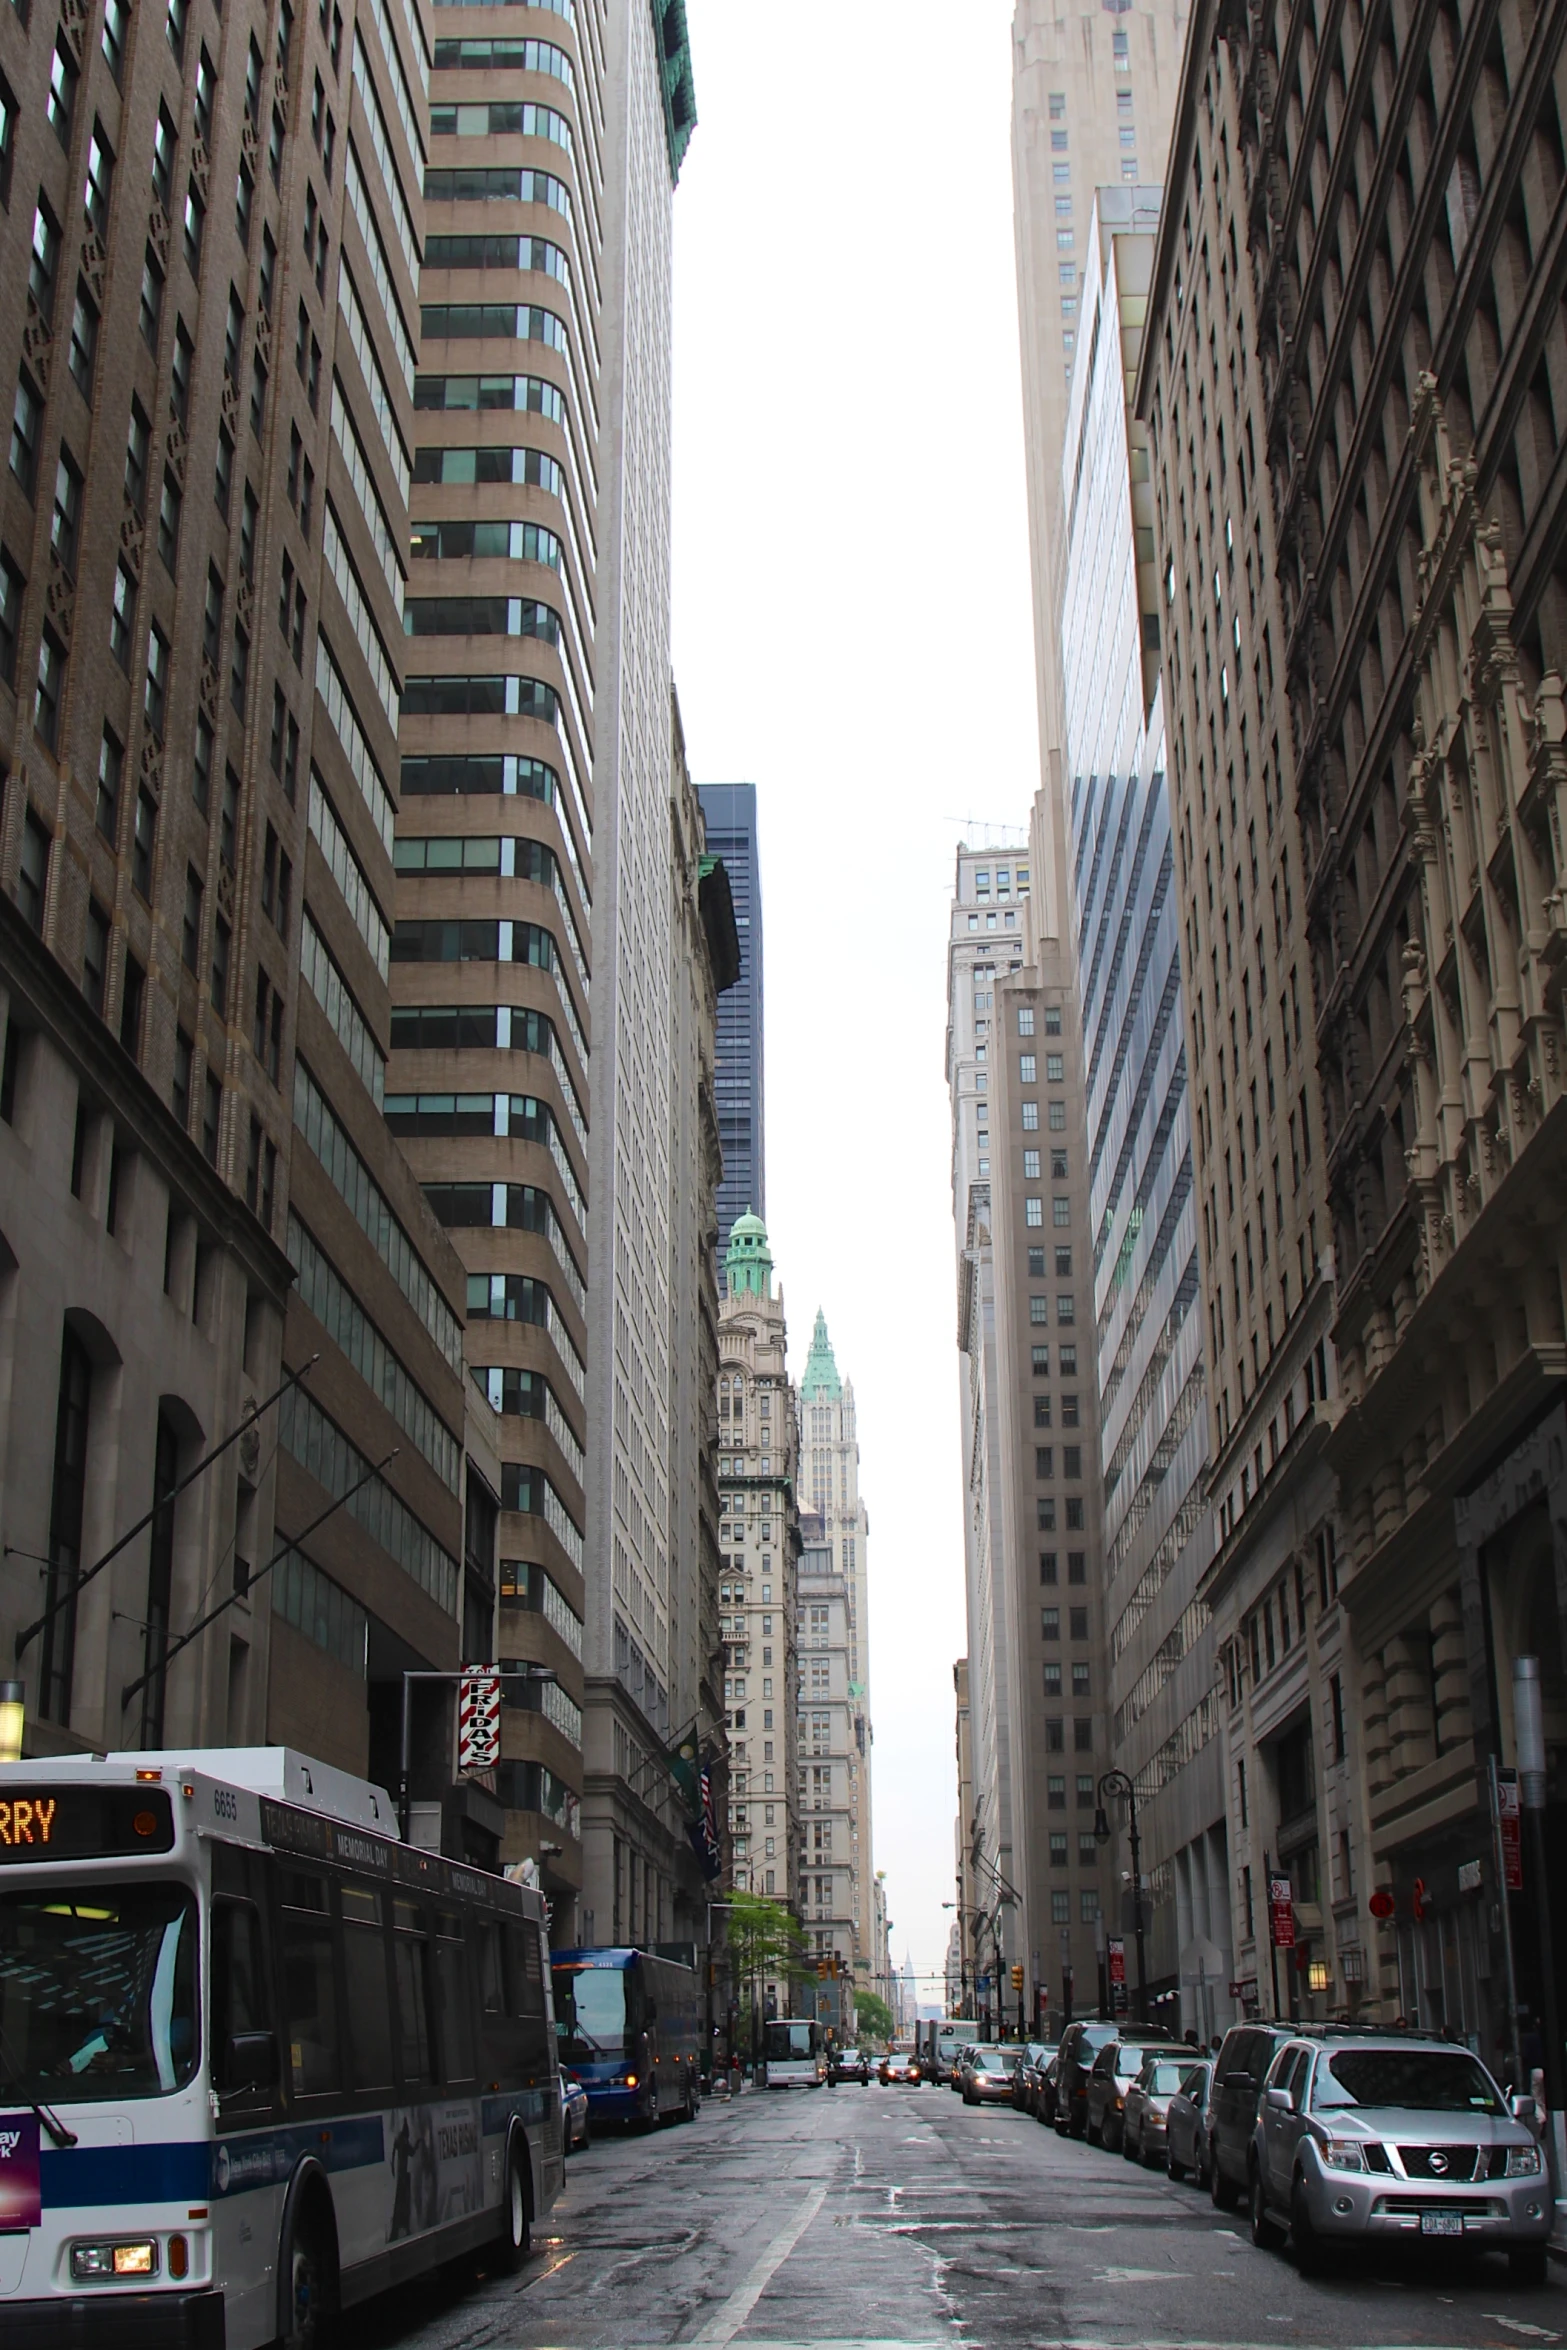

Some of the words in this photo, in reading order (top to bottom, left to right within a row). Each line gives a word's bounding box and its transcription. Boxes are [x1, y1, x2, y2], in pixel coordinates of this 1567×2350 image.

[214, 1789, 237, 1821] 6655
[337, 1833, 374, 1866] MEMORIAL
[375, 1845, 388, 1868] DAY
[452, 1871, 477, 1895] MEMORIAL
[477, 1879, 487, 1897] DAY
